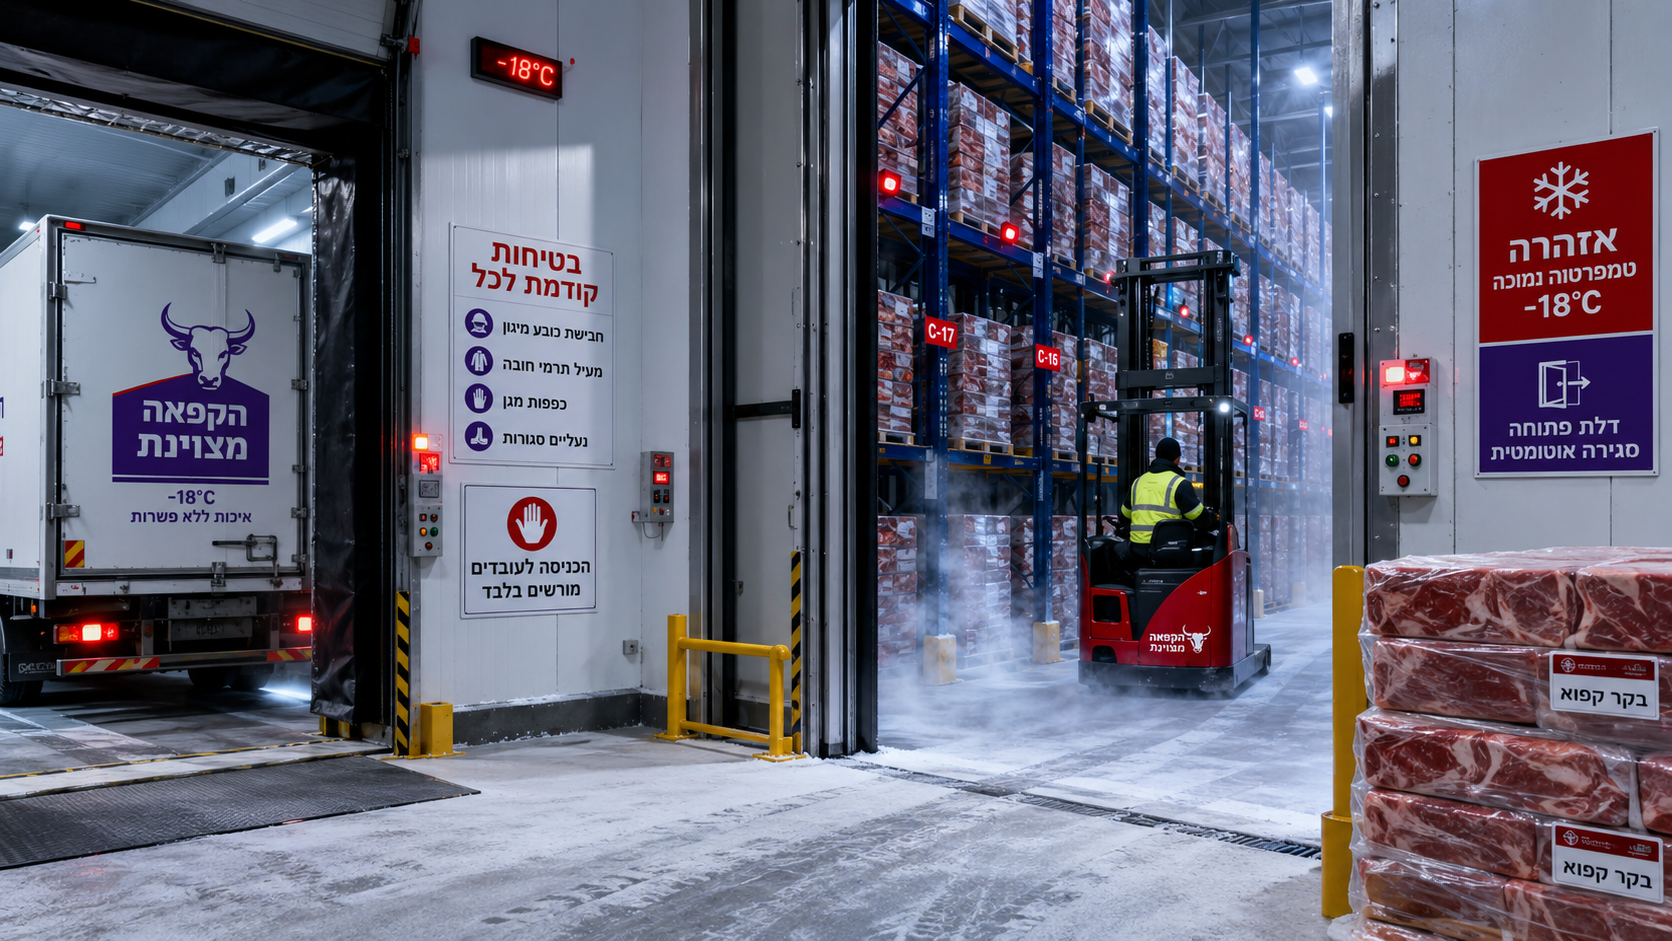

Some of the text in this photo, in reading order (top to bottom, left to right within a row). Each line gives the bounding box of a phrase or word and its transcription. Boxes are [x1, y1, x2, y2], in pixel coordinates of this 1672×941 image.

[497, 57, 554, 86] -18°C
[1509, 228, 1618, 263] אזהרה
[491, 241, 582, 275] בטיחות
[471, 262, 599, 308] קודמת לכל
[1493, 261, 1637, 291] טמפרטוה נמוכה
[1524, 289, 1602, 318] -18°C
[502, 321, 604, 342] חבישת כובע מיגון
[928, 322, 955, 343] C-17
[502, 358, 603, 378] מעיל תרמי חובה
[1038, 349, 1058, 366] C-16
[502, 395, 567, 410] כפפות מגן
[142, 399, 248, 431] הקפאה
[1509, 416, 1620, 437] דלת פתוחה
[137, 433, 248, 460] מצוינת
[502, 432, 588, 447] נעליים סגורות
[1490, 443, 1640, 460] סגירה אוטומטית
[167, 489, 216, 505] -18°C
[130, 508, 252, 523] איכות ללא פשרות
[471, 558, 591, 576] הכניסה לעובדים
[482, 581, 581, 599] מורשים בלבד
[1560, 687, 1648, 709] בקר קפוא
[1563, 860, 1653, 889] בקר קפוא
